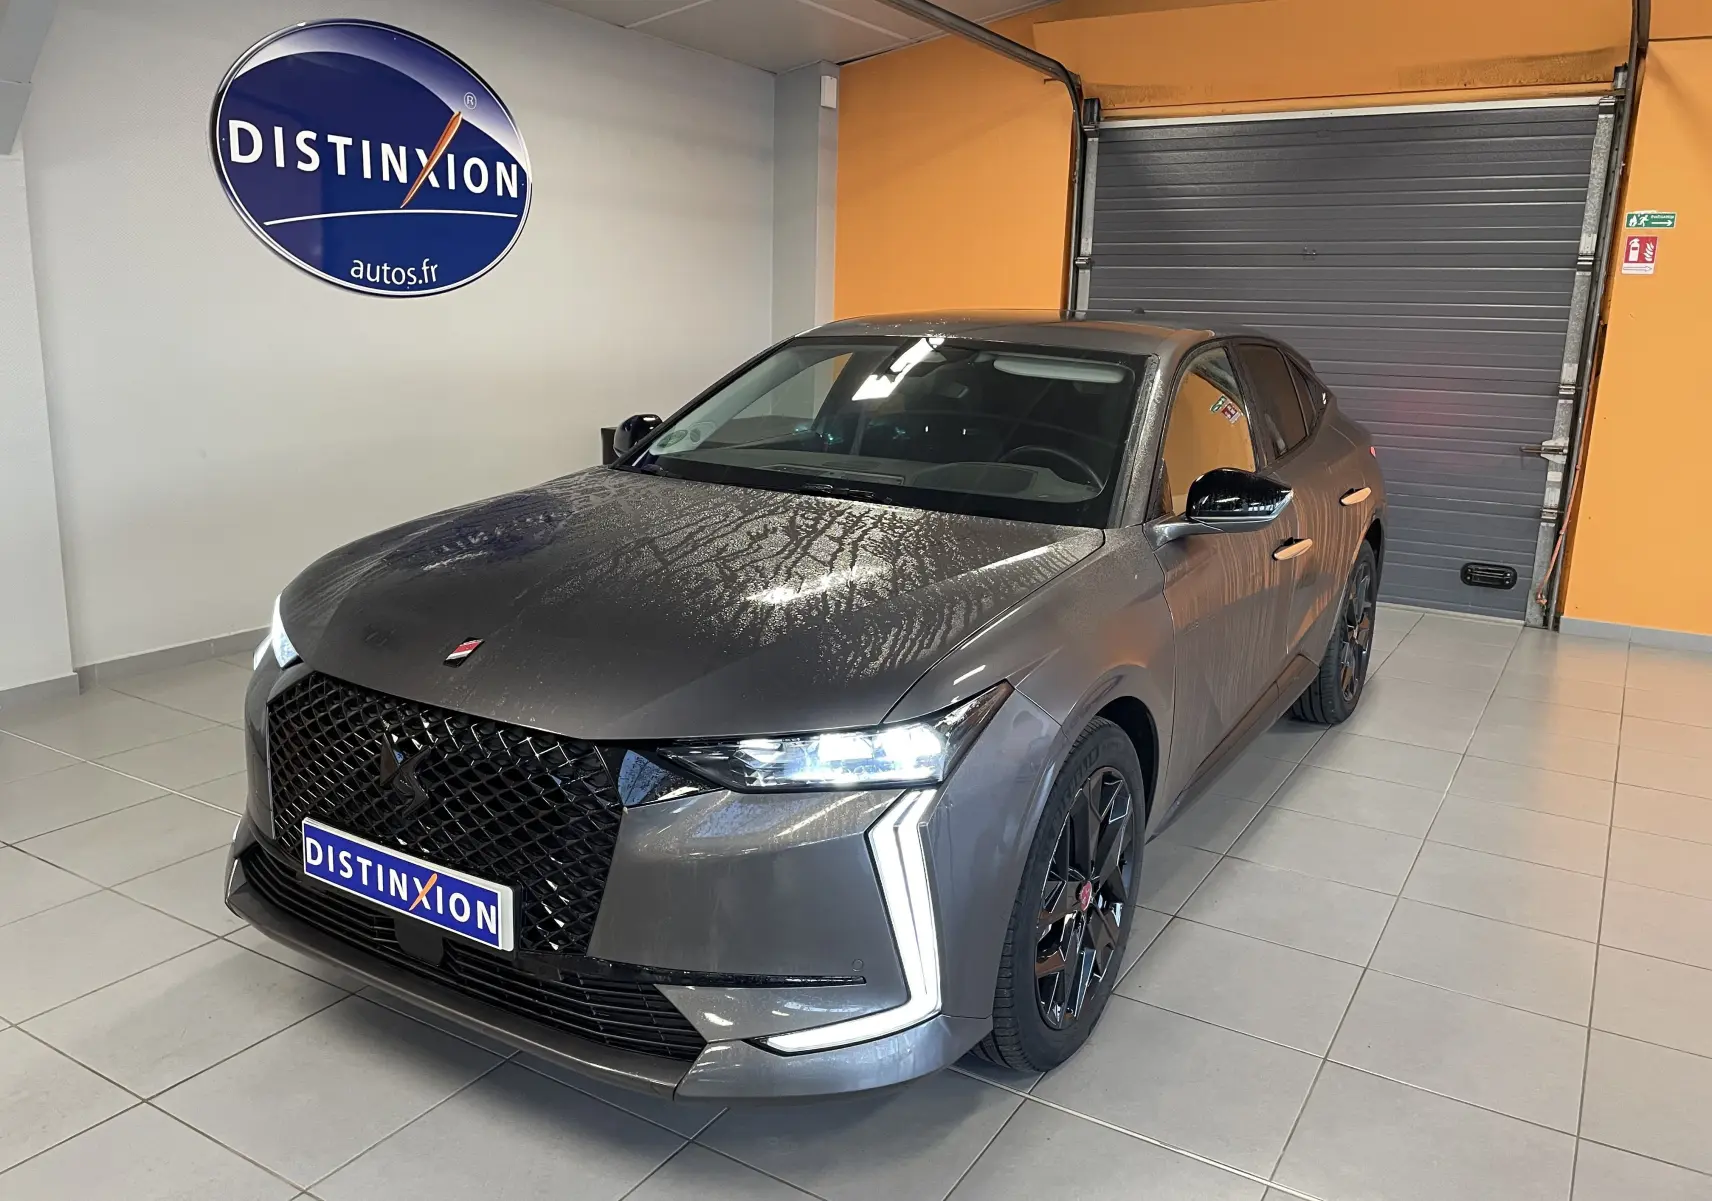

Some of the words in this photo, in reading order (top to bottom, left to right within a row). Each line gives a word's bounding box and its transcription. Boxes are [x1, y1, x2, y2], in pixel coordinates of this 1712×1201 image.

[228, 112, 518, 207] DISTINXION
[350, 258, 438, 285] autos.fr
[305, 837, 497, 935] DISTINXION
